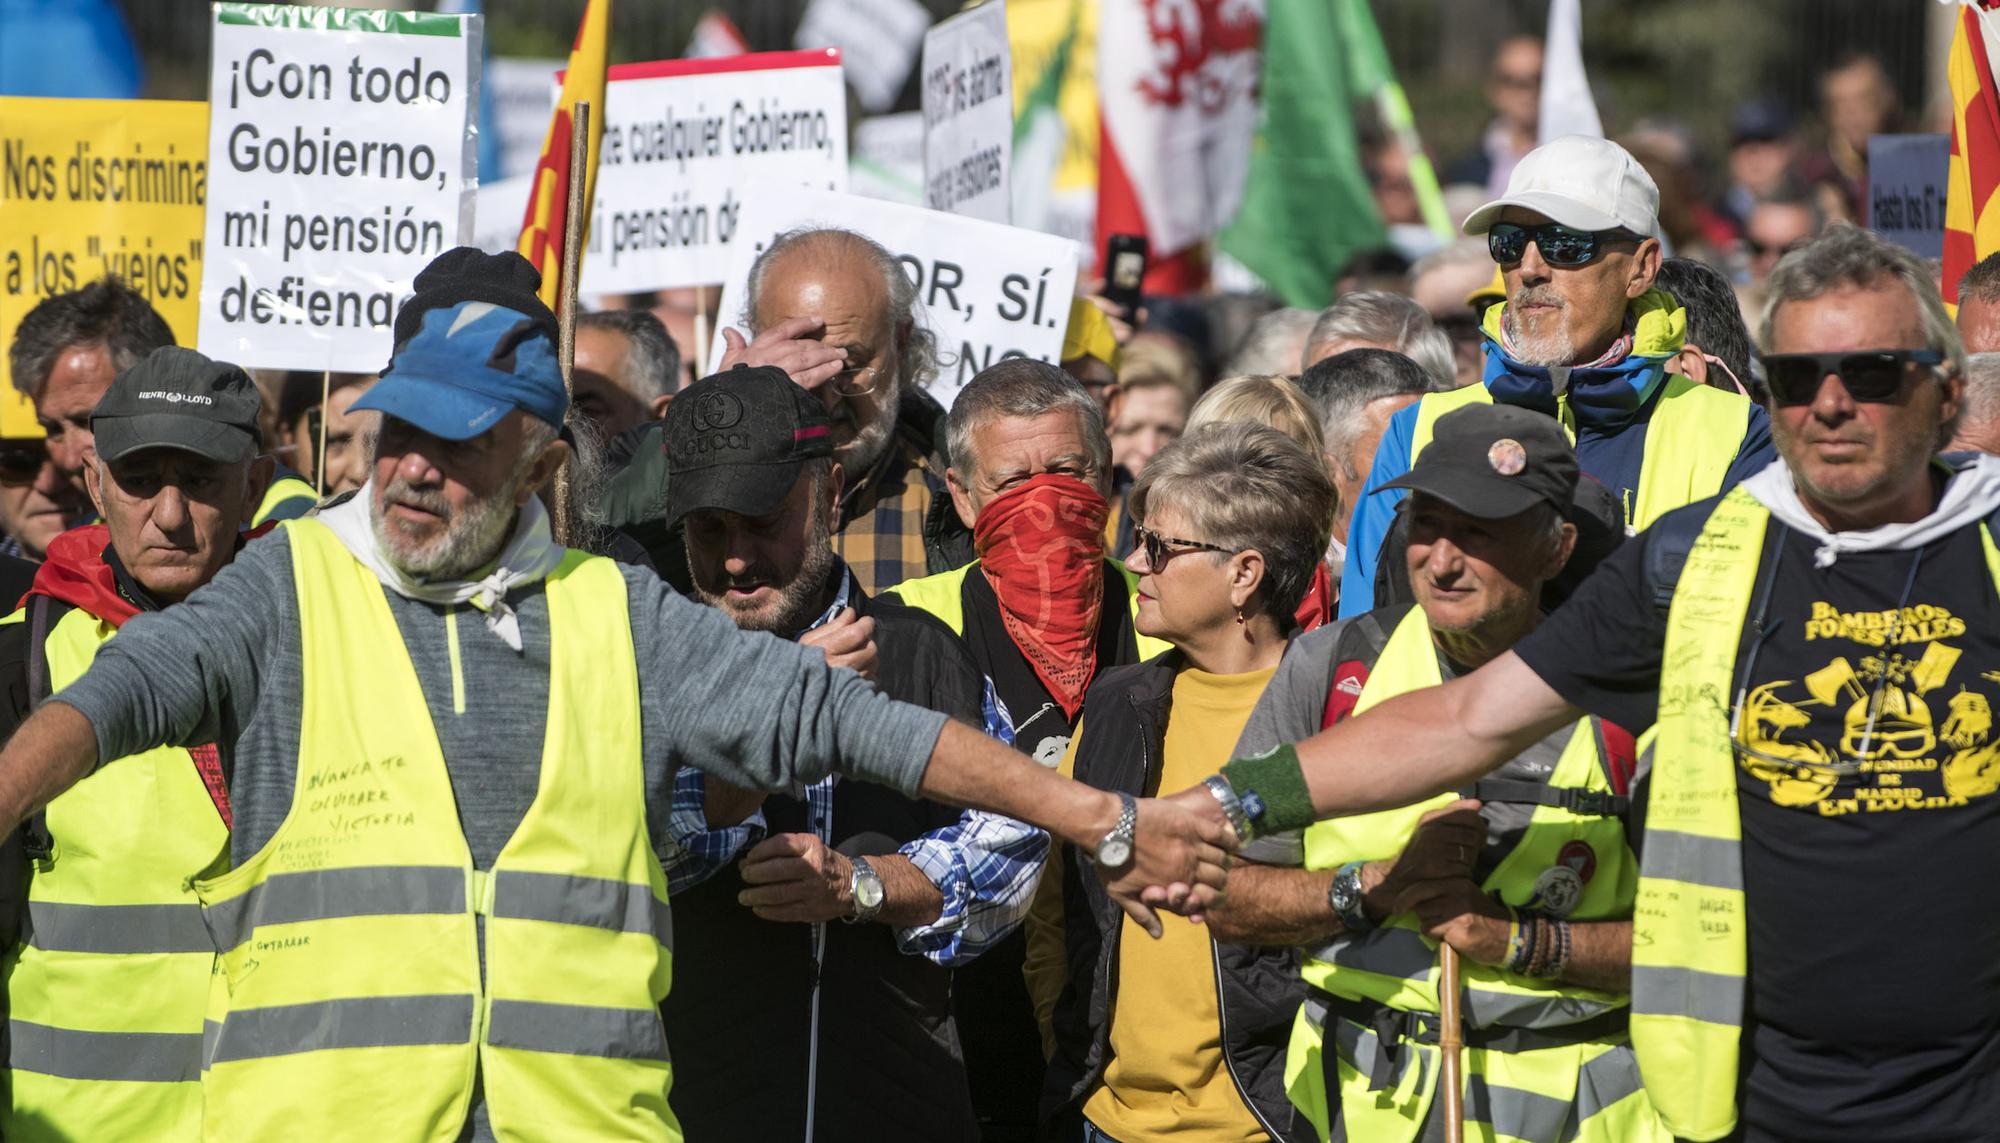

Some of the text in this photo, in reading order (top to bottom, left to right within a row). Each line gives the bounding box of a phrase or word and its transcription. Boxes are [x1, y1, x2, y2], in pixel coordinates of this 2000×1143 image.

[231, 48, 451, 108] ¡Con todo
[228, 123, 447, 191] Gobierno,
[630, 105, 723, 174] cualquier
[731, 97, 835, 160] Gobierno,
[4, 138, 57, 201] Nos
[223, 200, 443, 263] mi pensión
[613, 190, 708, 268] pensión
[7, 249, 22, 296] a
[32, 234, 77, 297] los
[220, 275, 410, 328] defiend
[997, 267, 1056, 328] SÍ.
[138, 391, 213, 406] HENRI LLOYD
[1853, 787, 1923, 801] MADRID
[1877, 773, 1902, 787] DE
